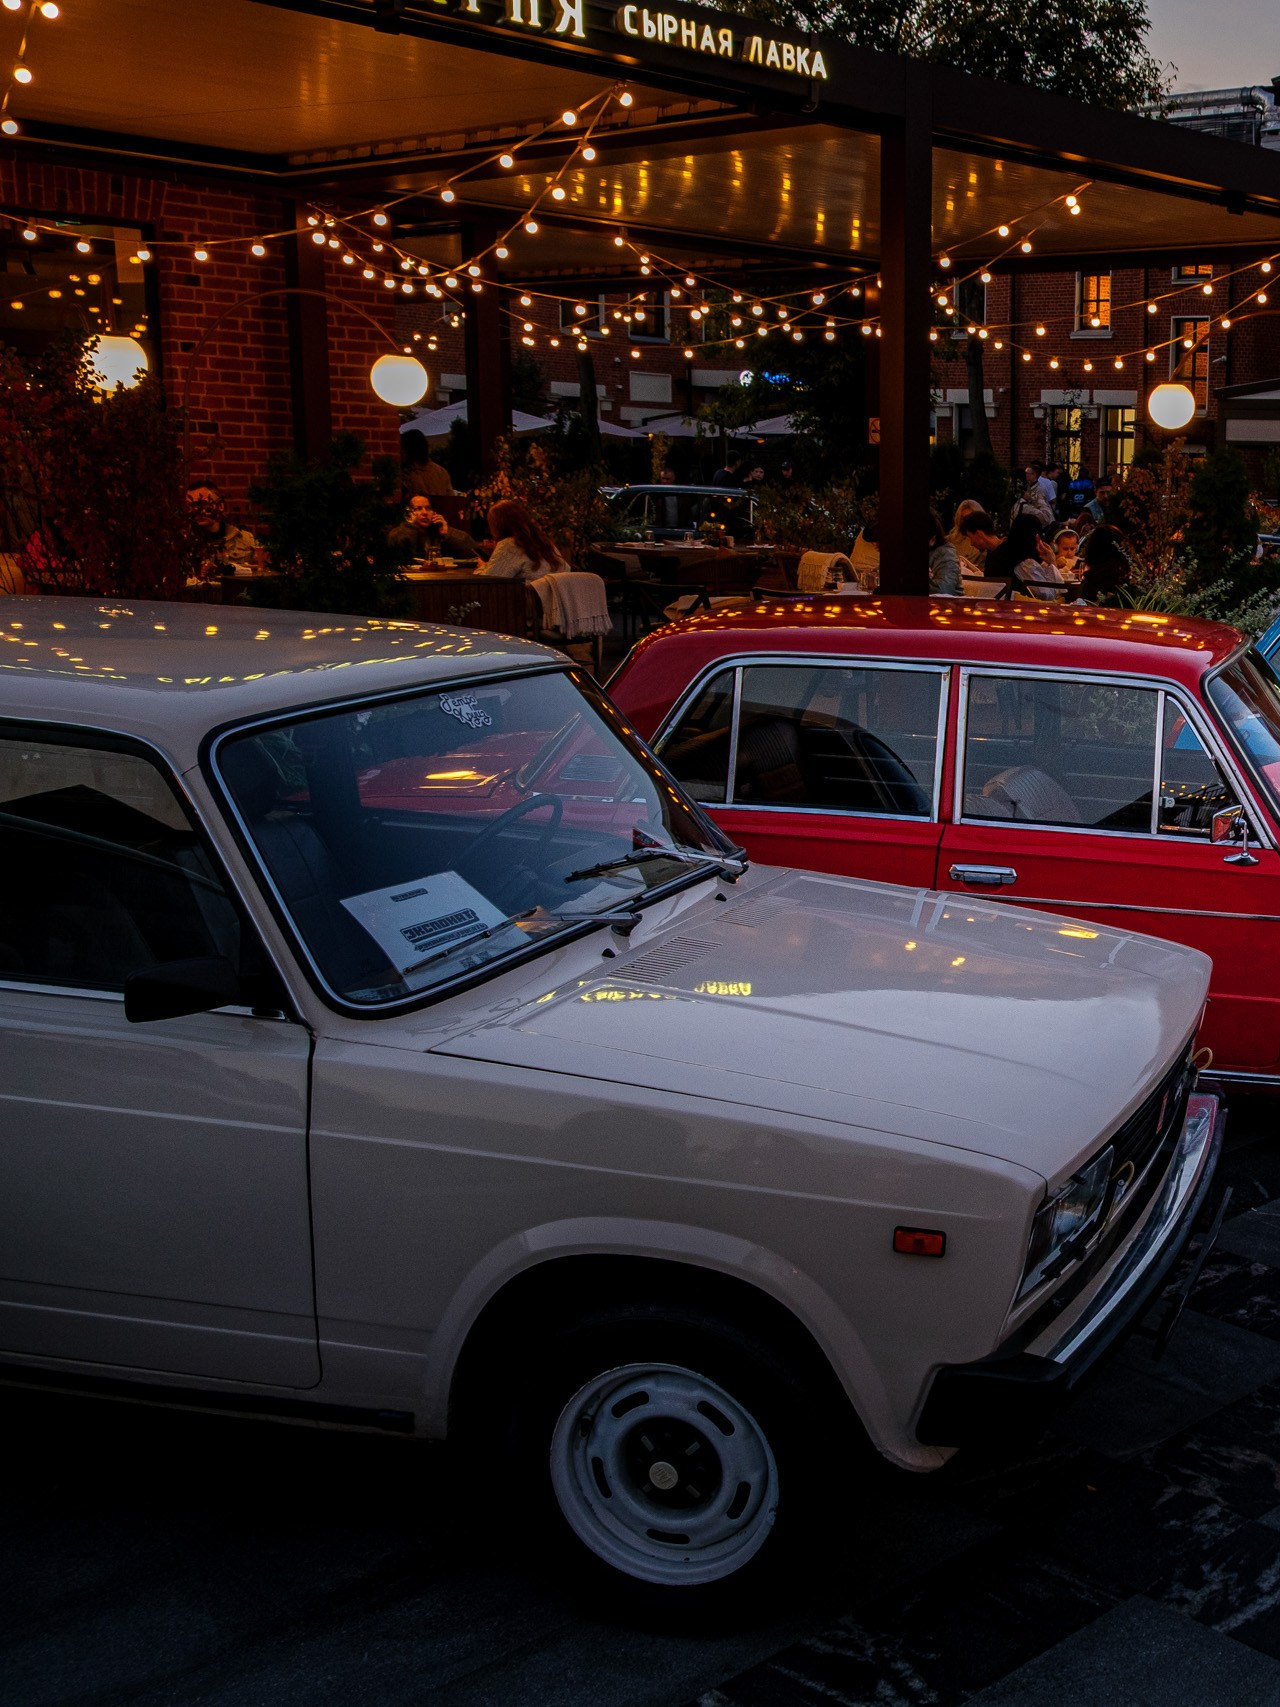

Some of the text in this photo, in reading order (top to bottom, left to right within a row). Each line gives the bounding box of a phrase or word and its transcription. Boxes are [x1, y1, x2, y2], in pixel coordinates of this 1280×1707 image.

[623, 4, 733, 58] СЫРНАЯ
[748, 35, 828, 79] ЛАВКА
[402, 910, 473, 941] ЭКСПОНАТ
